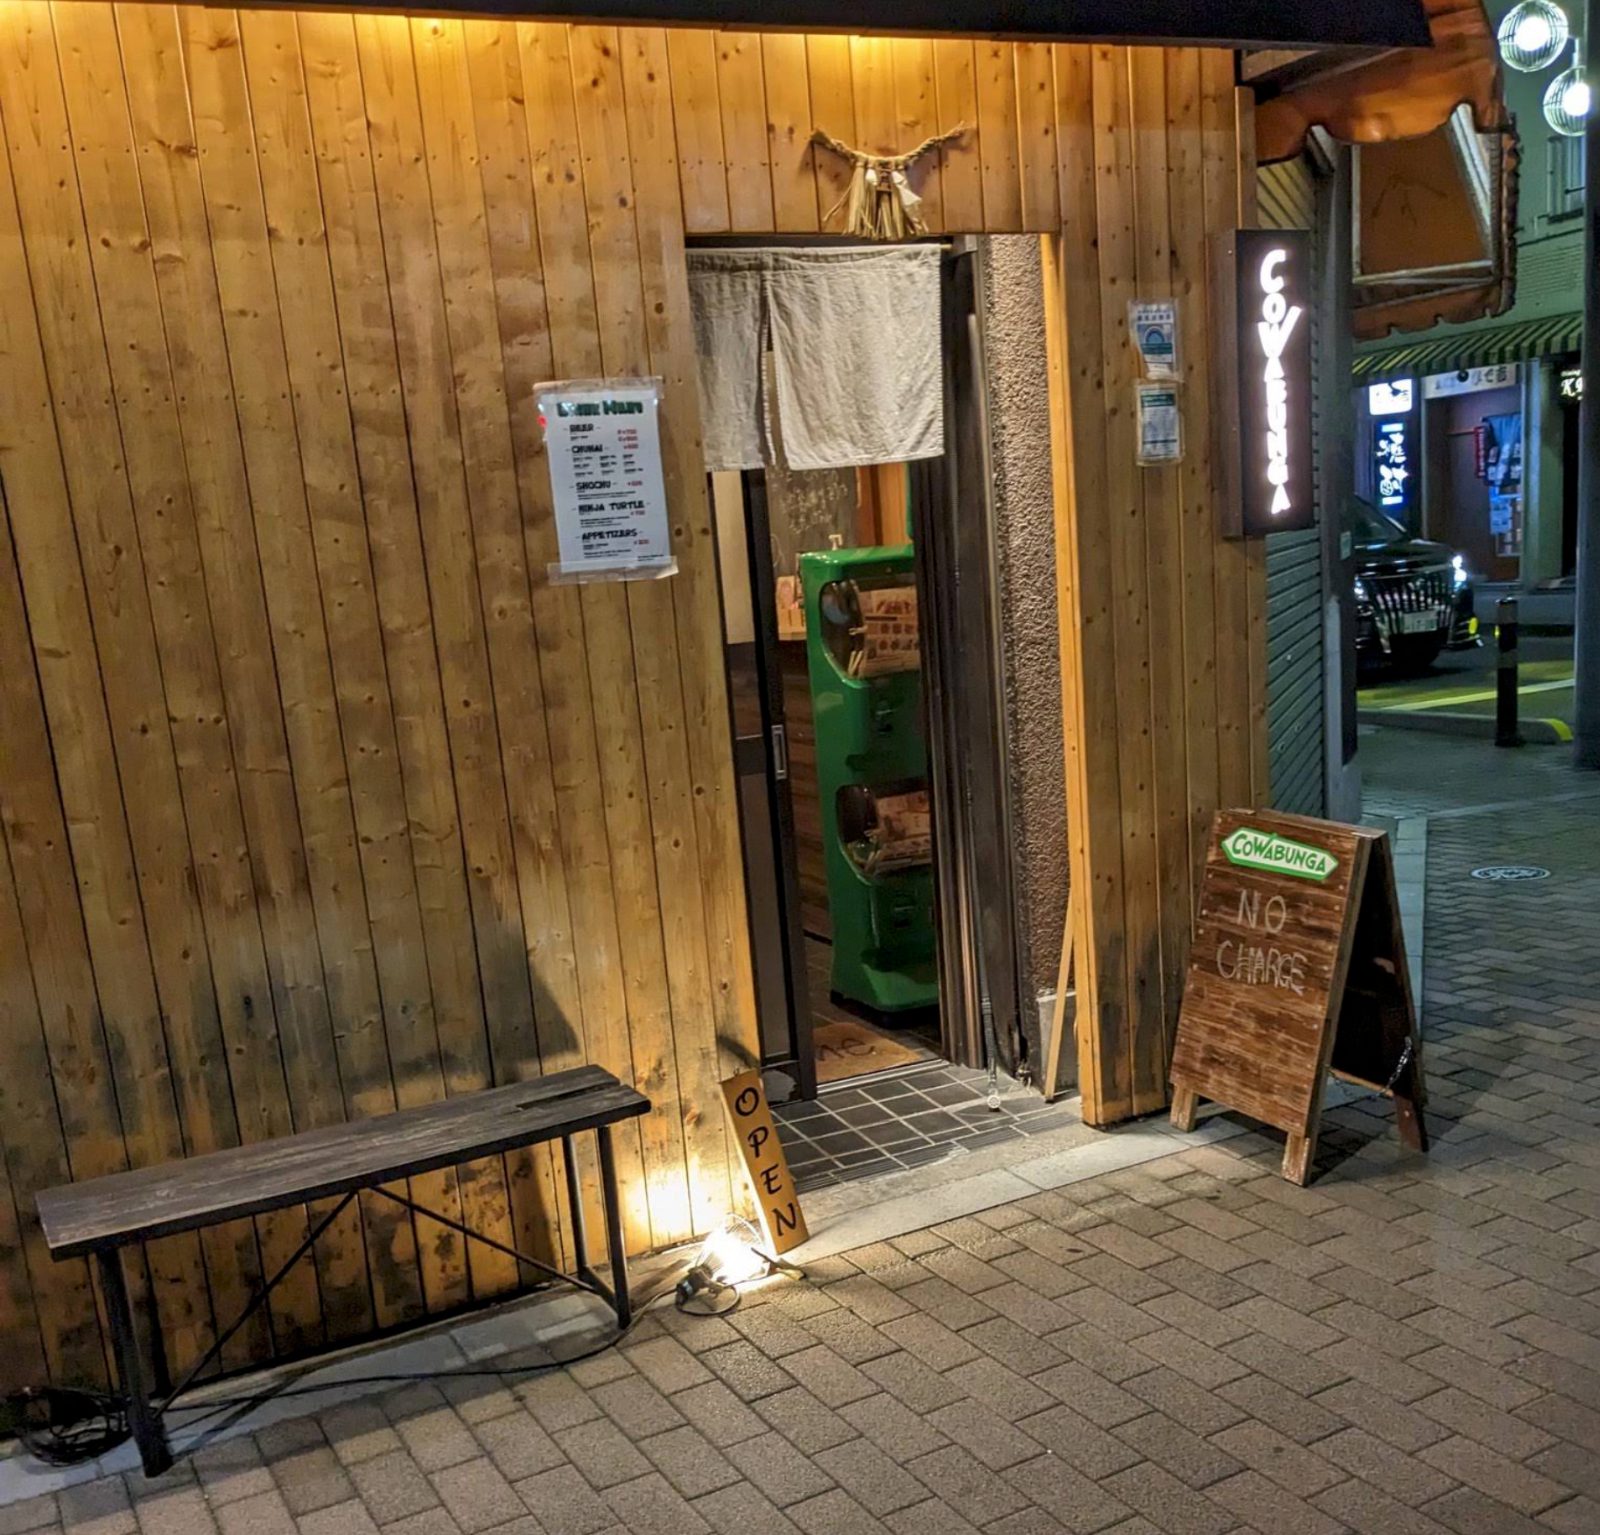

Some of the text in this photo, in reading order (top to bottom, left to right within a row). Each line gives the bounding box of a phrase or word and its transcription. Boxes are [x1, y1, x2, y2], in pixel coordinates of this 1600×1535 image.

[1258, 248, 1302, 515] COWABUNGA
[576, 480, 611, 490] SHOCHU
[578, 500, 645, 513] NINJA TURTLE
[582, 528, 638, 540] APPETIZERS
[1231, 833, 1326, 873] COWABUNGA
[1238, 889, 1287, 933] NO
[1216, 940, 1309, 996] CHARGE
[735, 1087, 797, 1237] OPEN
